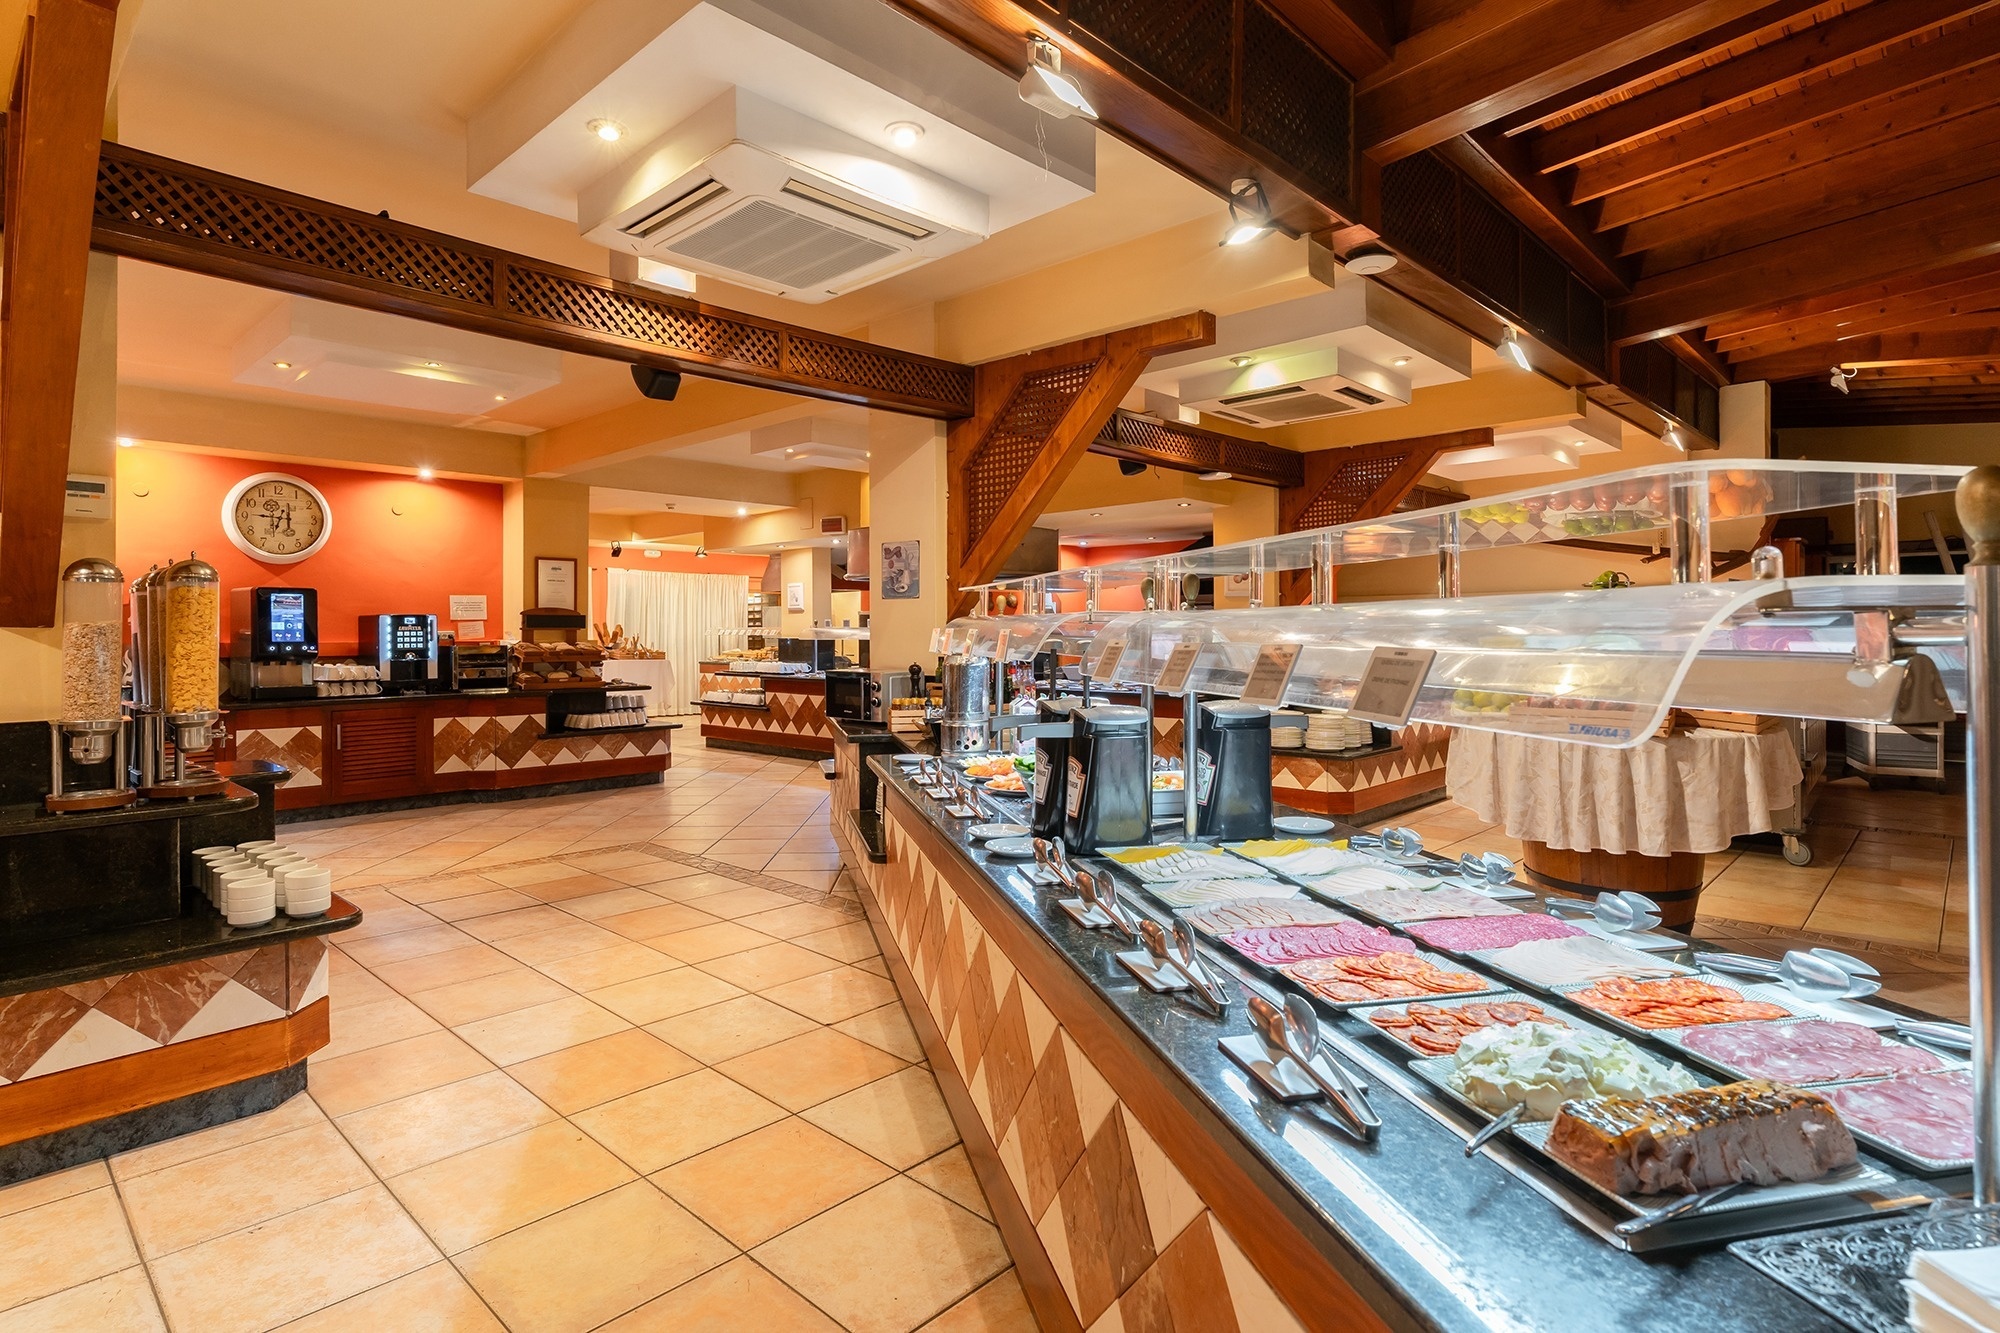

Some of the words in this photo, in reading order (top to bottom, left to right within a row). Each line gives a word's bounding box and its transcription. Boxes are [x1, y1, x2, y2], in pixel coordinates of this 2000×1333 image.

[258, 488, 265, 498] 11
[274, 485, 283, 495] 12
[294, 490, 298, 499] 1
[246, 498, 256, 508] 10
[306, 500, 313, 510] 2
[241, 510, 249, 522] 9
[311, 514, 318, 525] 3
[247, 525, 255, 536] 8
[307, 529, 314, 538] 4
[260, 537, 267, 547] 7
[277, 541, 285, 551] 6
[295, 538, 302, 548] 5
[1581, 725, 1618, 738] FRIUSA
